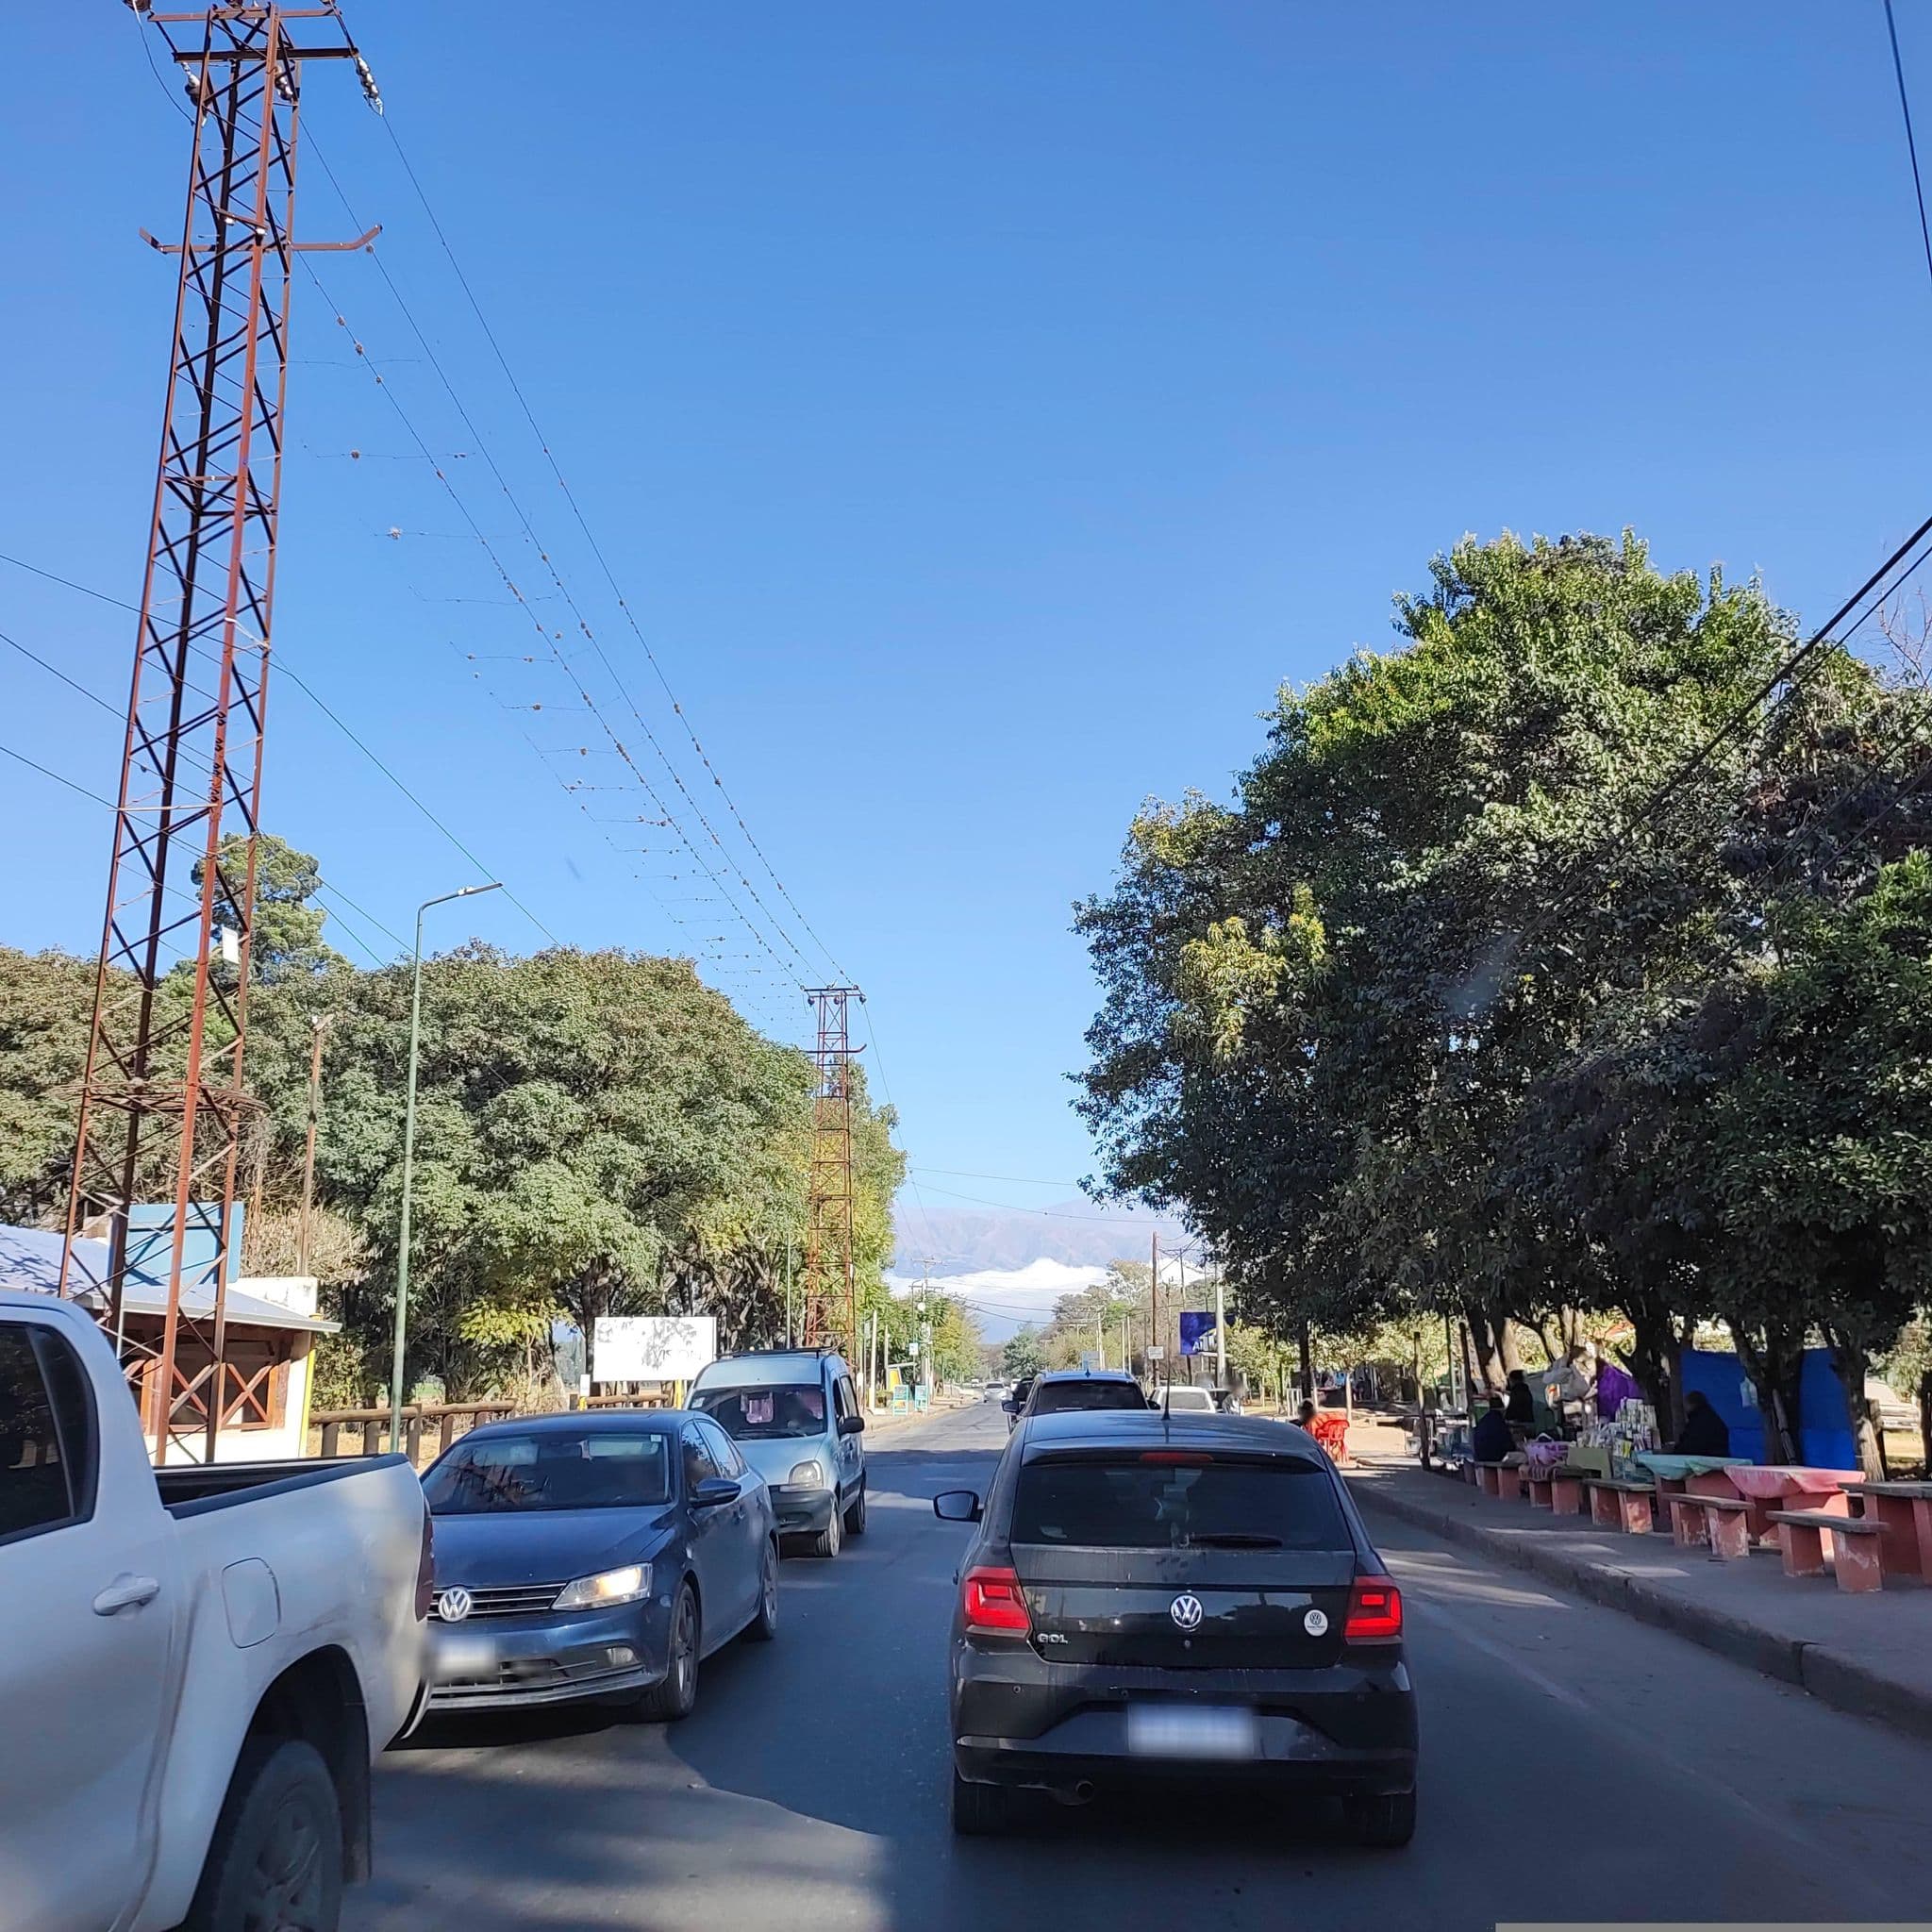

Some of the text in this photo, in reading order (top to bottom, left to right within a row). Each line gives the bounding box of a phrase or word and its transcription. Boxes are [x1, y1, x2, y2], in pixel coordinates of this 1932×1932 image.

[439, 1586, 471, 1622] VW
[1171, 1595, 1202, 1628] VW
[1037, 1633, 1068, 1643] GOL
